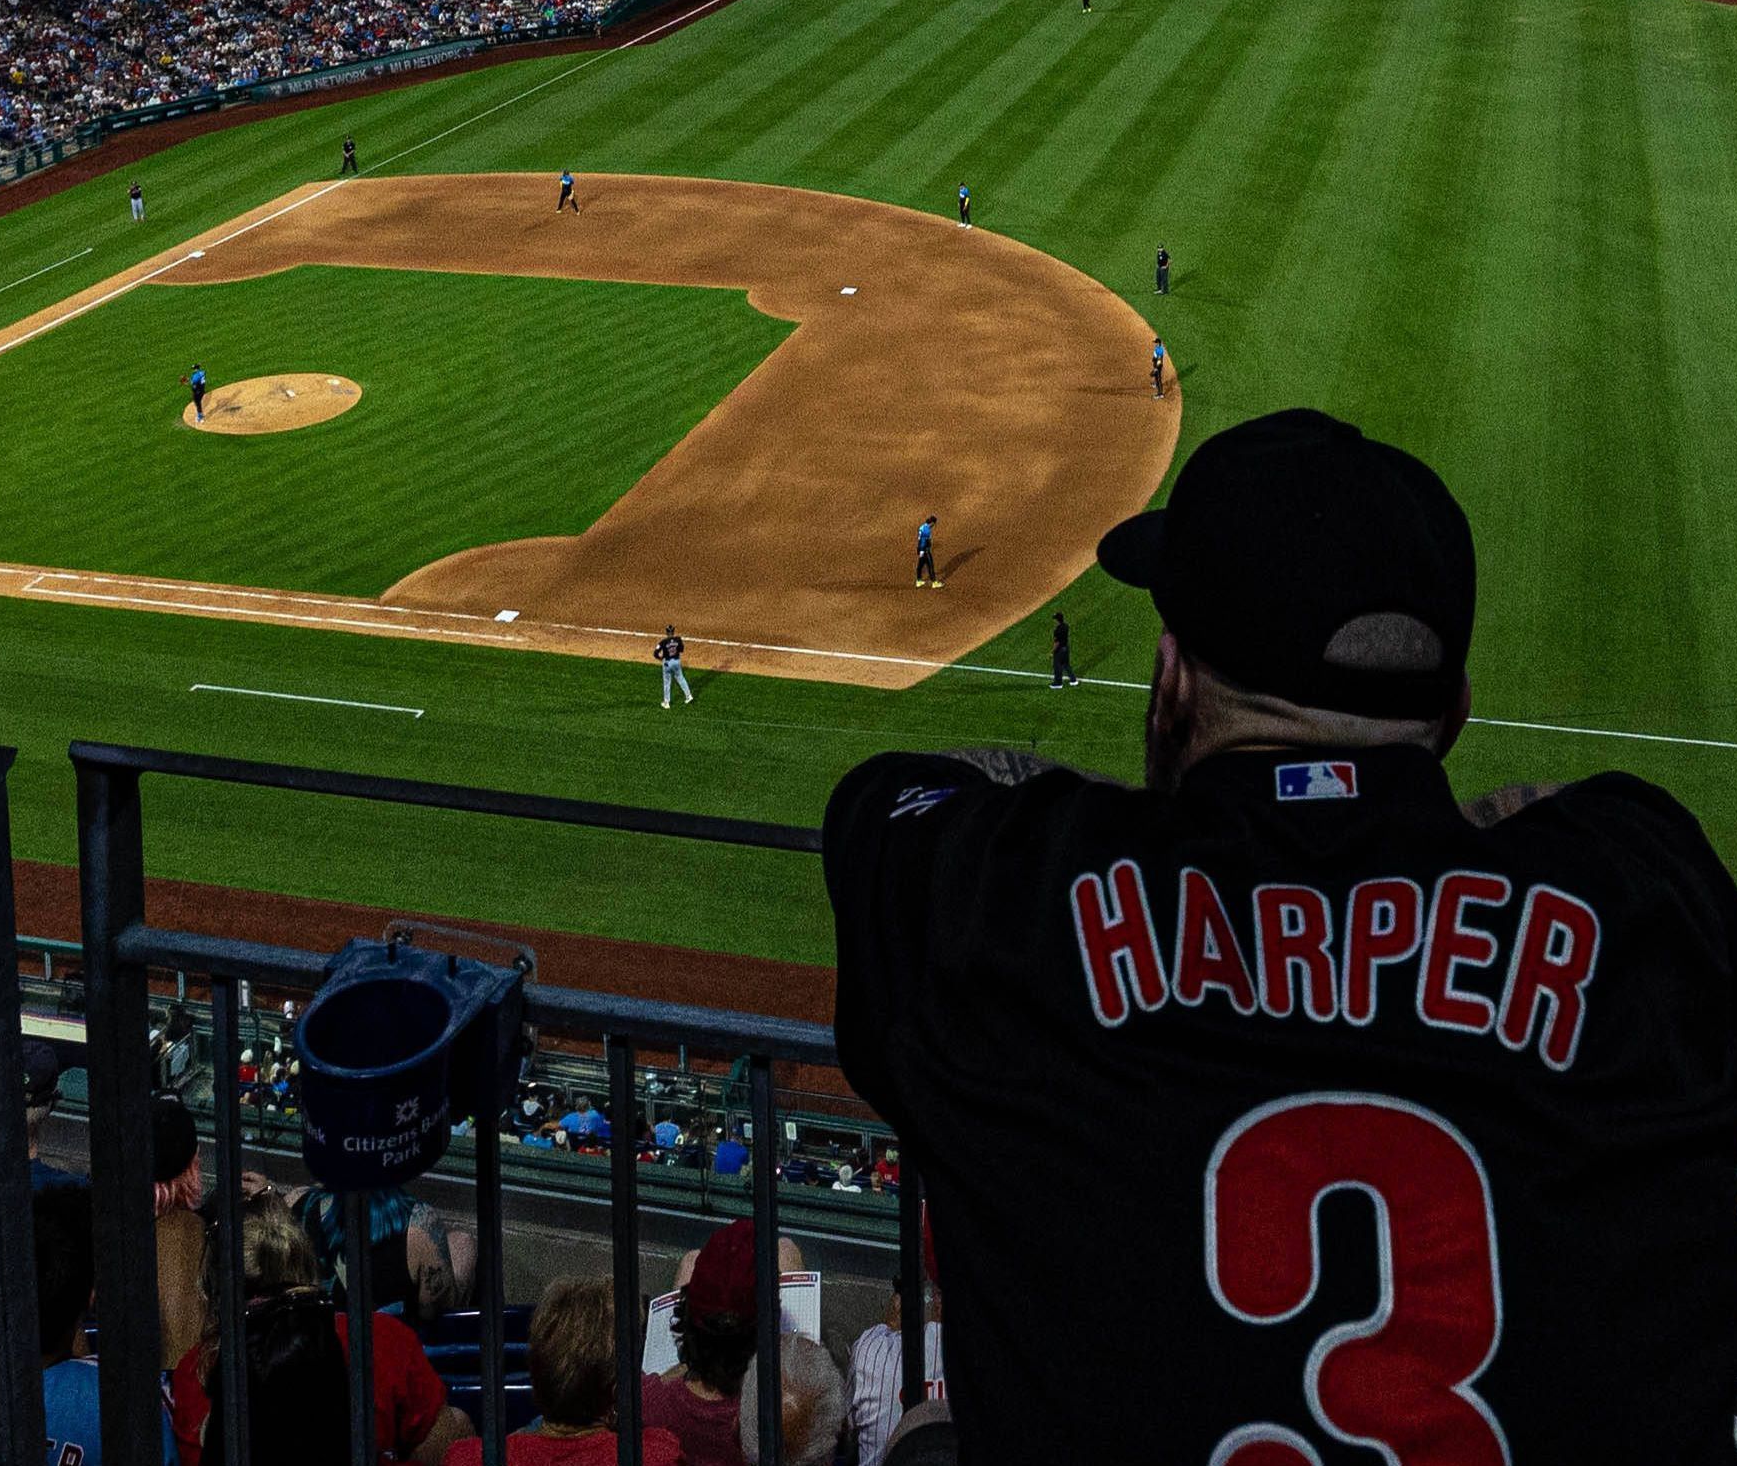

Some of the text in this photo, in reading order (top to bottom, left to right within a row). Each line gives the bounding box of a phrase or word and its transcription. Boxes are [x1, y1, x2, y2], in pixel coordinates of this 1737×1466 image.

[1071, 859, 1601, 1070] HARPER
[343, 1128, 418, 1152] Citizens
[382, 1142, 421, 1168] Park
[1204, 1090, 1512, 1466] 3
